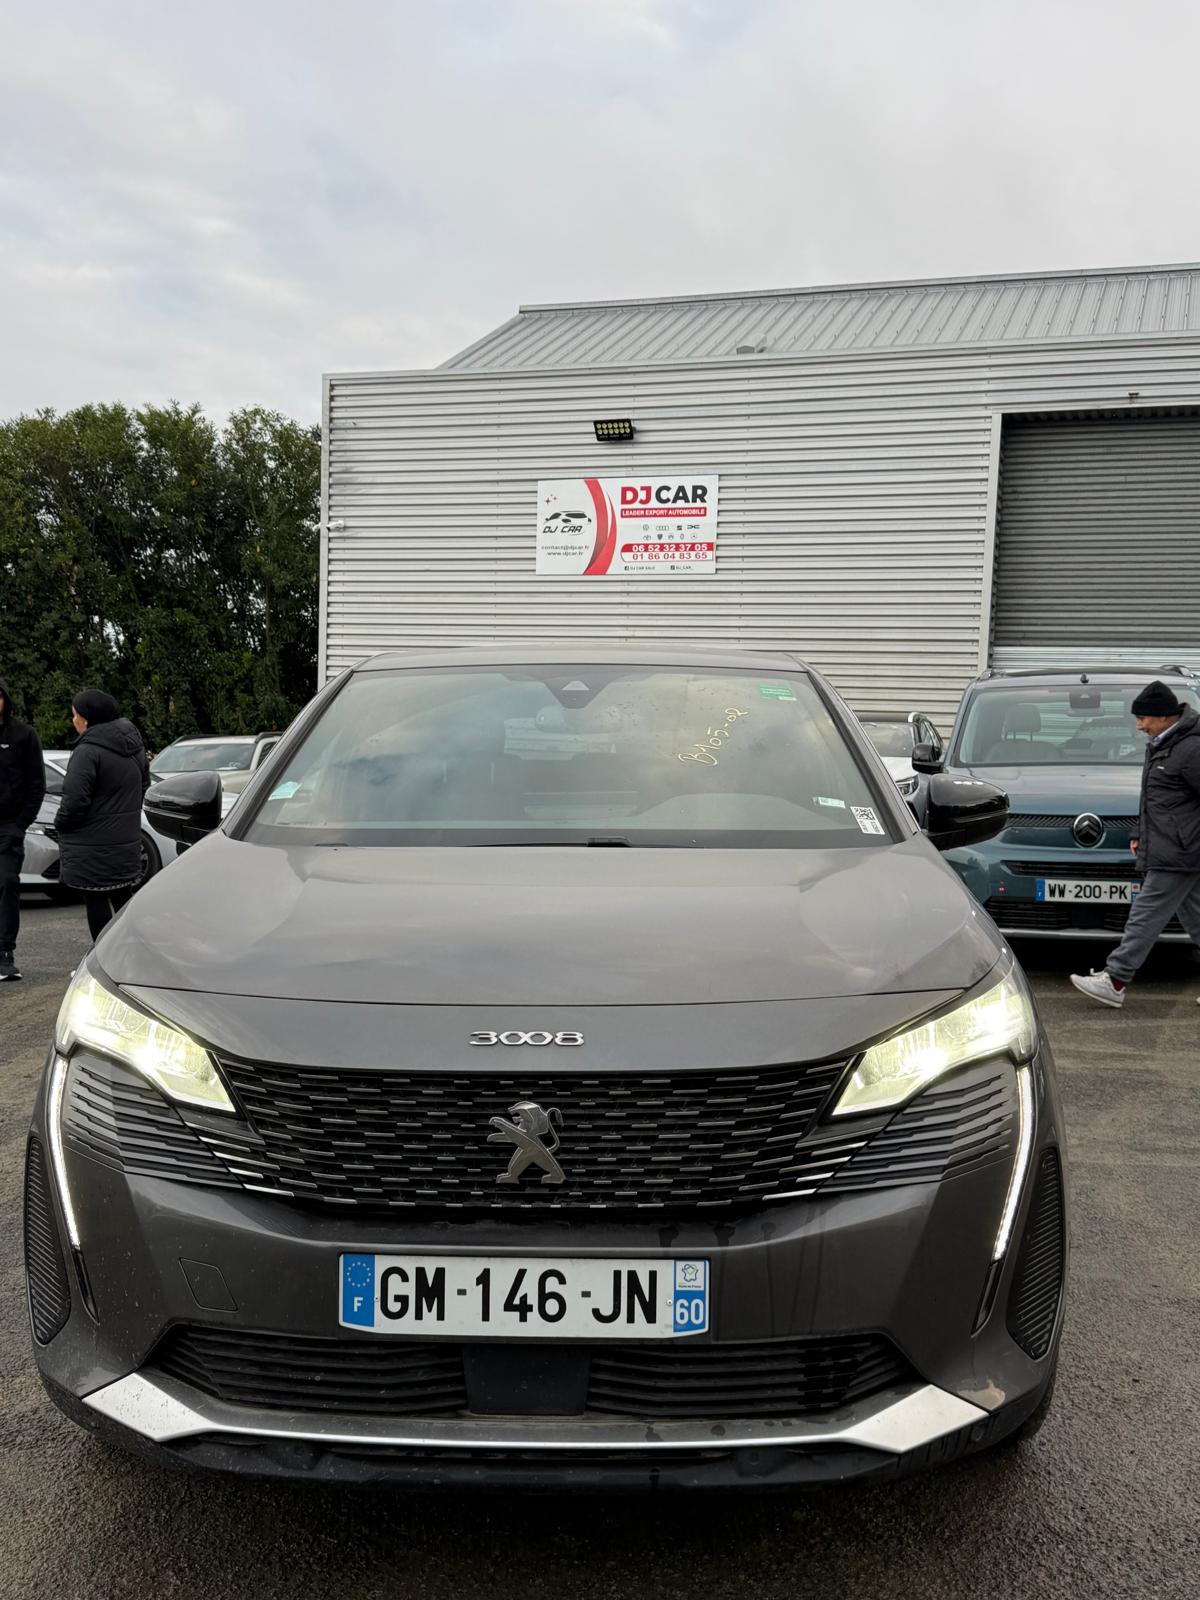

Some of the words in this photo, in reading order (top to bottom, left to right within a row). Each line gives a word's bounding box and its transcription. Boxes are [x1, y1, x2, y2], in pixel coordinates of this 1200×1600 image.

[621, 486, 652, 505] DJ
[655, 485, 708, 504] CAR
[645, 508, 667, 516] EXPORT
[668, 507, 705, 515] AUTOMOBILE
[561, 525, 583, 533] CAR
[695, 543, 708, 551] 05
[632, 553, 644, 561] 01
[648, 552, 660, 560] 86
[663, 552, 675, 560] 04
[679, 552, 691, 560] 83
[1048, 884, 1128, 900] WW-200-PK
[469, 1030, 585, 1046] 3008
[380, 1265, 658, 1324] GM-146-JN
[354, 1296, 364, 1312] F
[675, 1298, 704, 1325] 60
